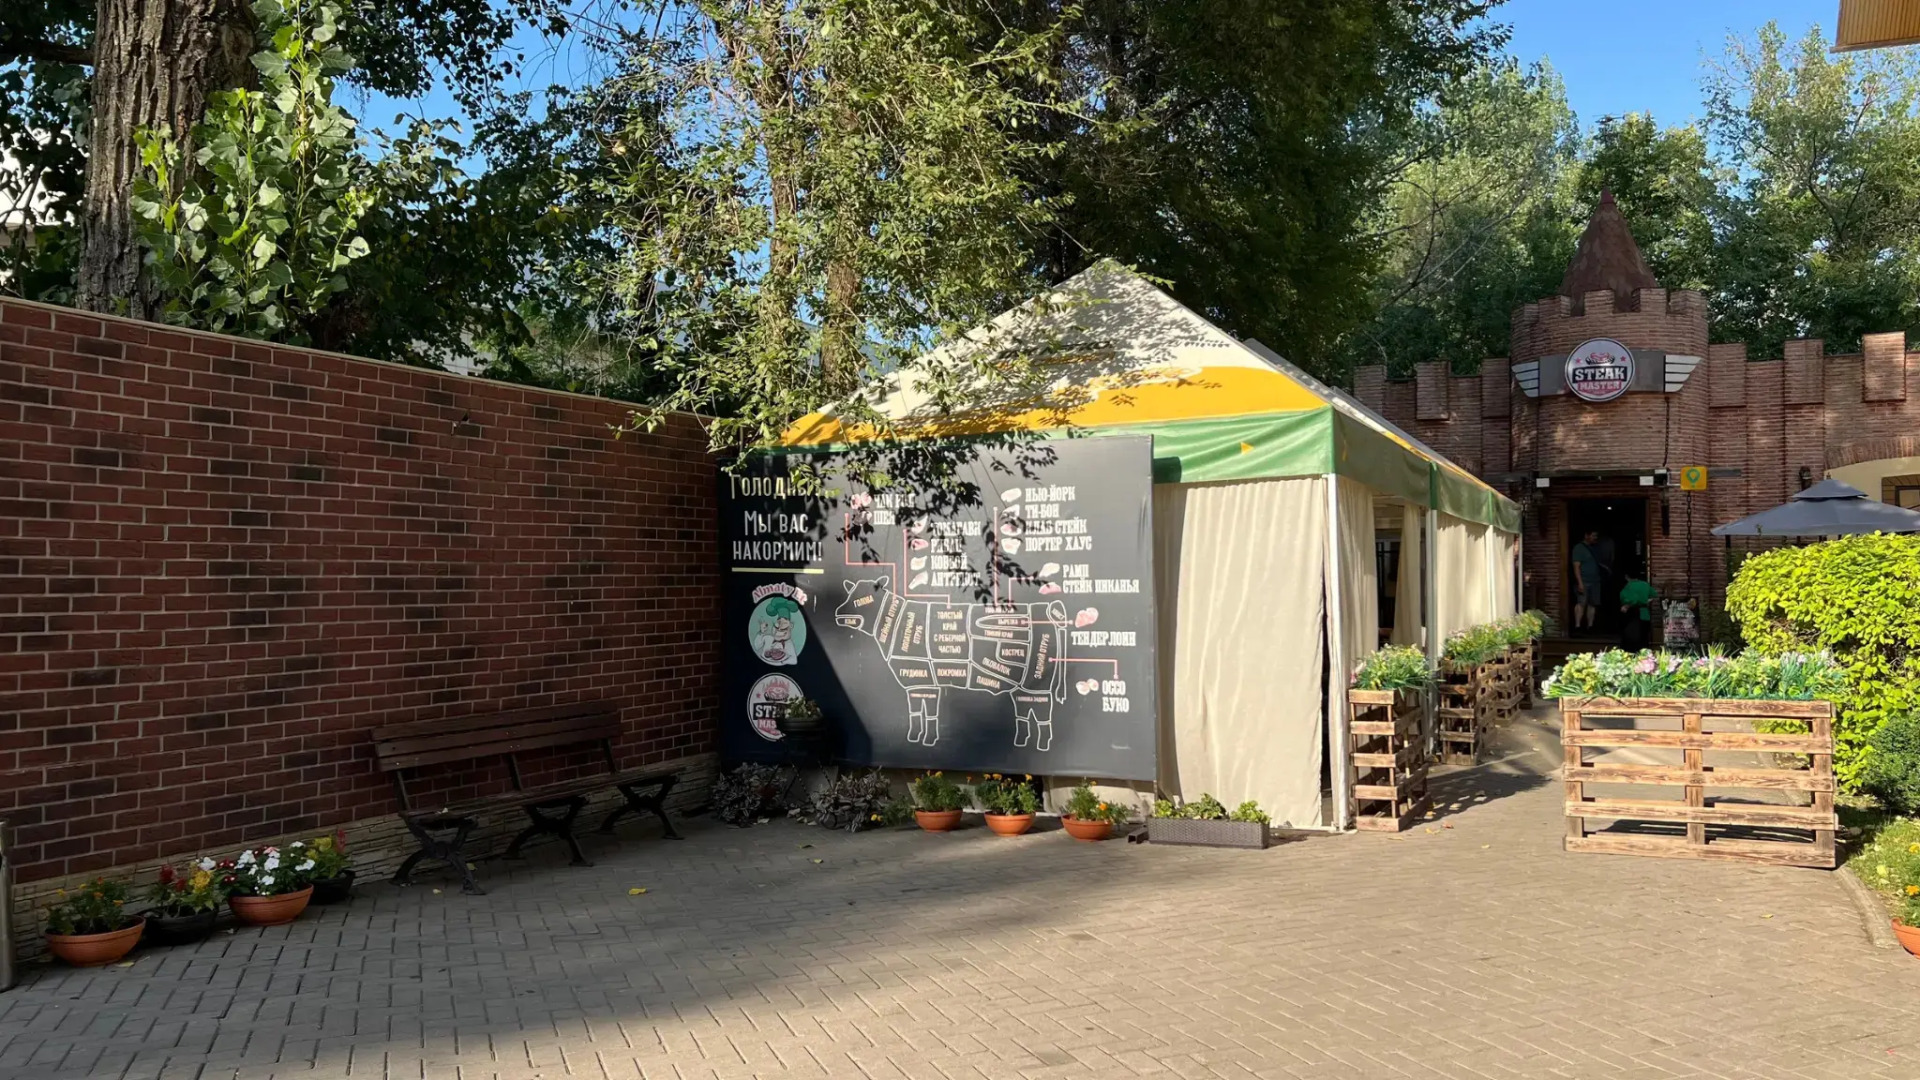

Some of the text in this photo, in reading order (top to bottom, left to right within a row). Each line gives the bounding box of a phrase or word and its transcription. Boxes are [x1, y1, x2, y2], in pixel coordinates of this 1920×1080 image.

[1575, 367, 1625, 381] STEAK
[1580, 381, 1620, 390] MASTER
[1025, 484, 1076, 502] НЬЮ-ЙОРК
[1025, 504, 1060, 519] ТИ-БОН
[744, 510, 809, 536] МЫ ВАС
[1055, 517, 1088, 534] СТЕЙК
[733, 540, 822, 561] НАКОРМИМ!
[1025, 536, 1093, 551] ПОРТЕР ХАУС
[1063, 564, 1090, 579] РАМП
[753, 582, 794, 603] Almaty
[1063, 577, 1140, 594] СТЕЙК ПИКАНЬЯ
[853, 595, 875, 608] ГОЛОВА
[936, 609, 963, 620] ТОЛСТЫЙ
[942, 621, 958, 631] КРАЙ
[912, 624, 924, 645] ОТРУБ
[938, 645, 962, 655] ЧАСТЬЮ
[900, 668, 928, 678] ГРУДИНКА
[936, 668, 967, 677] ПОКРОМКА
[1102, 680, 1126, 695] ОССО
[1102, 697, 1129, 712] БУКО
